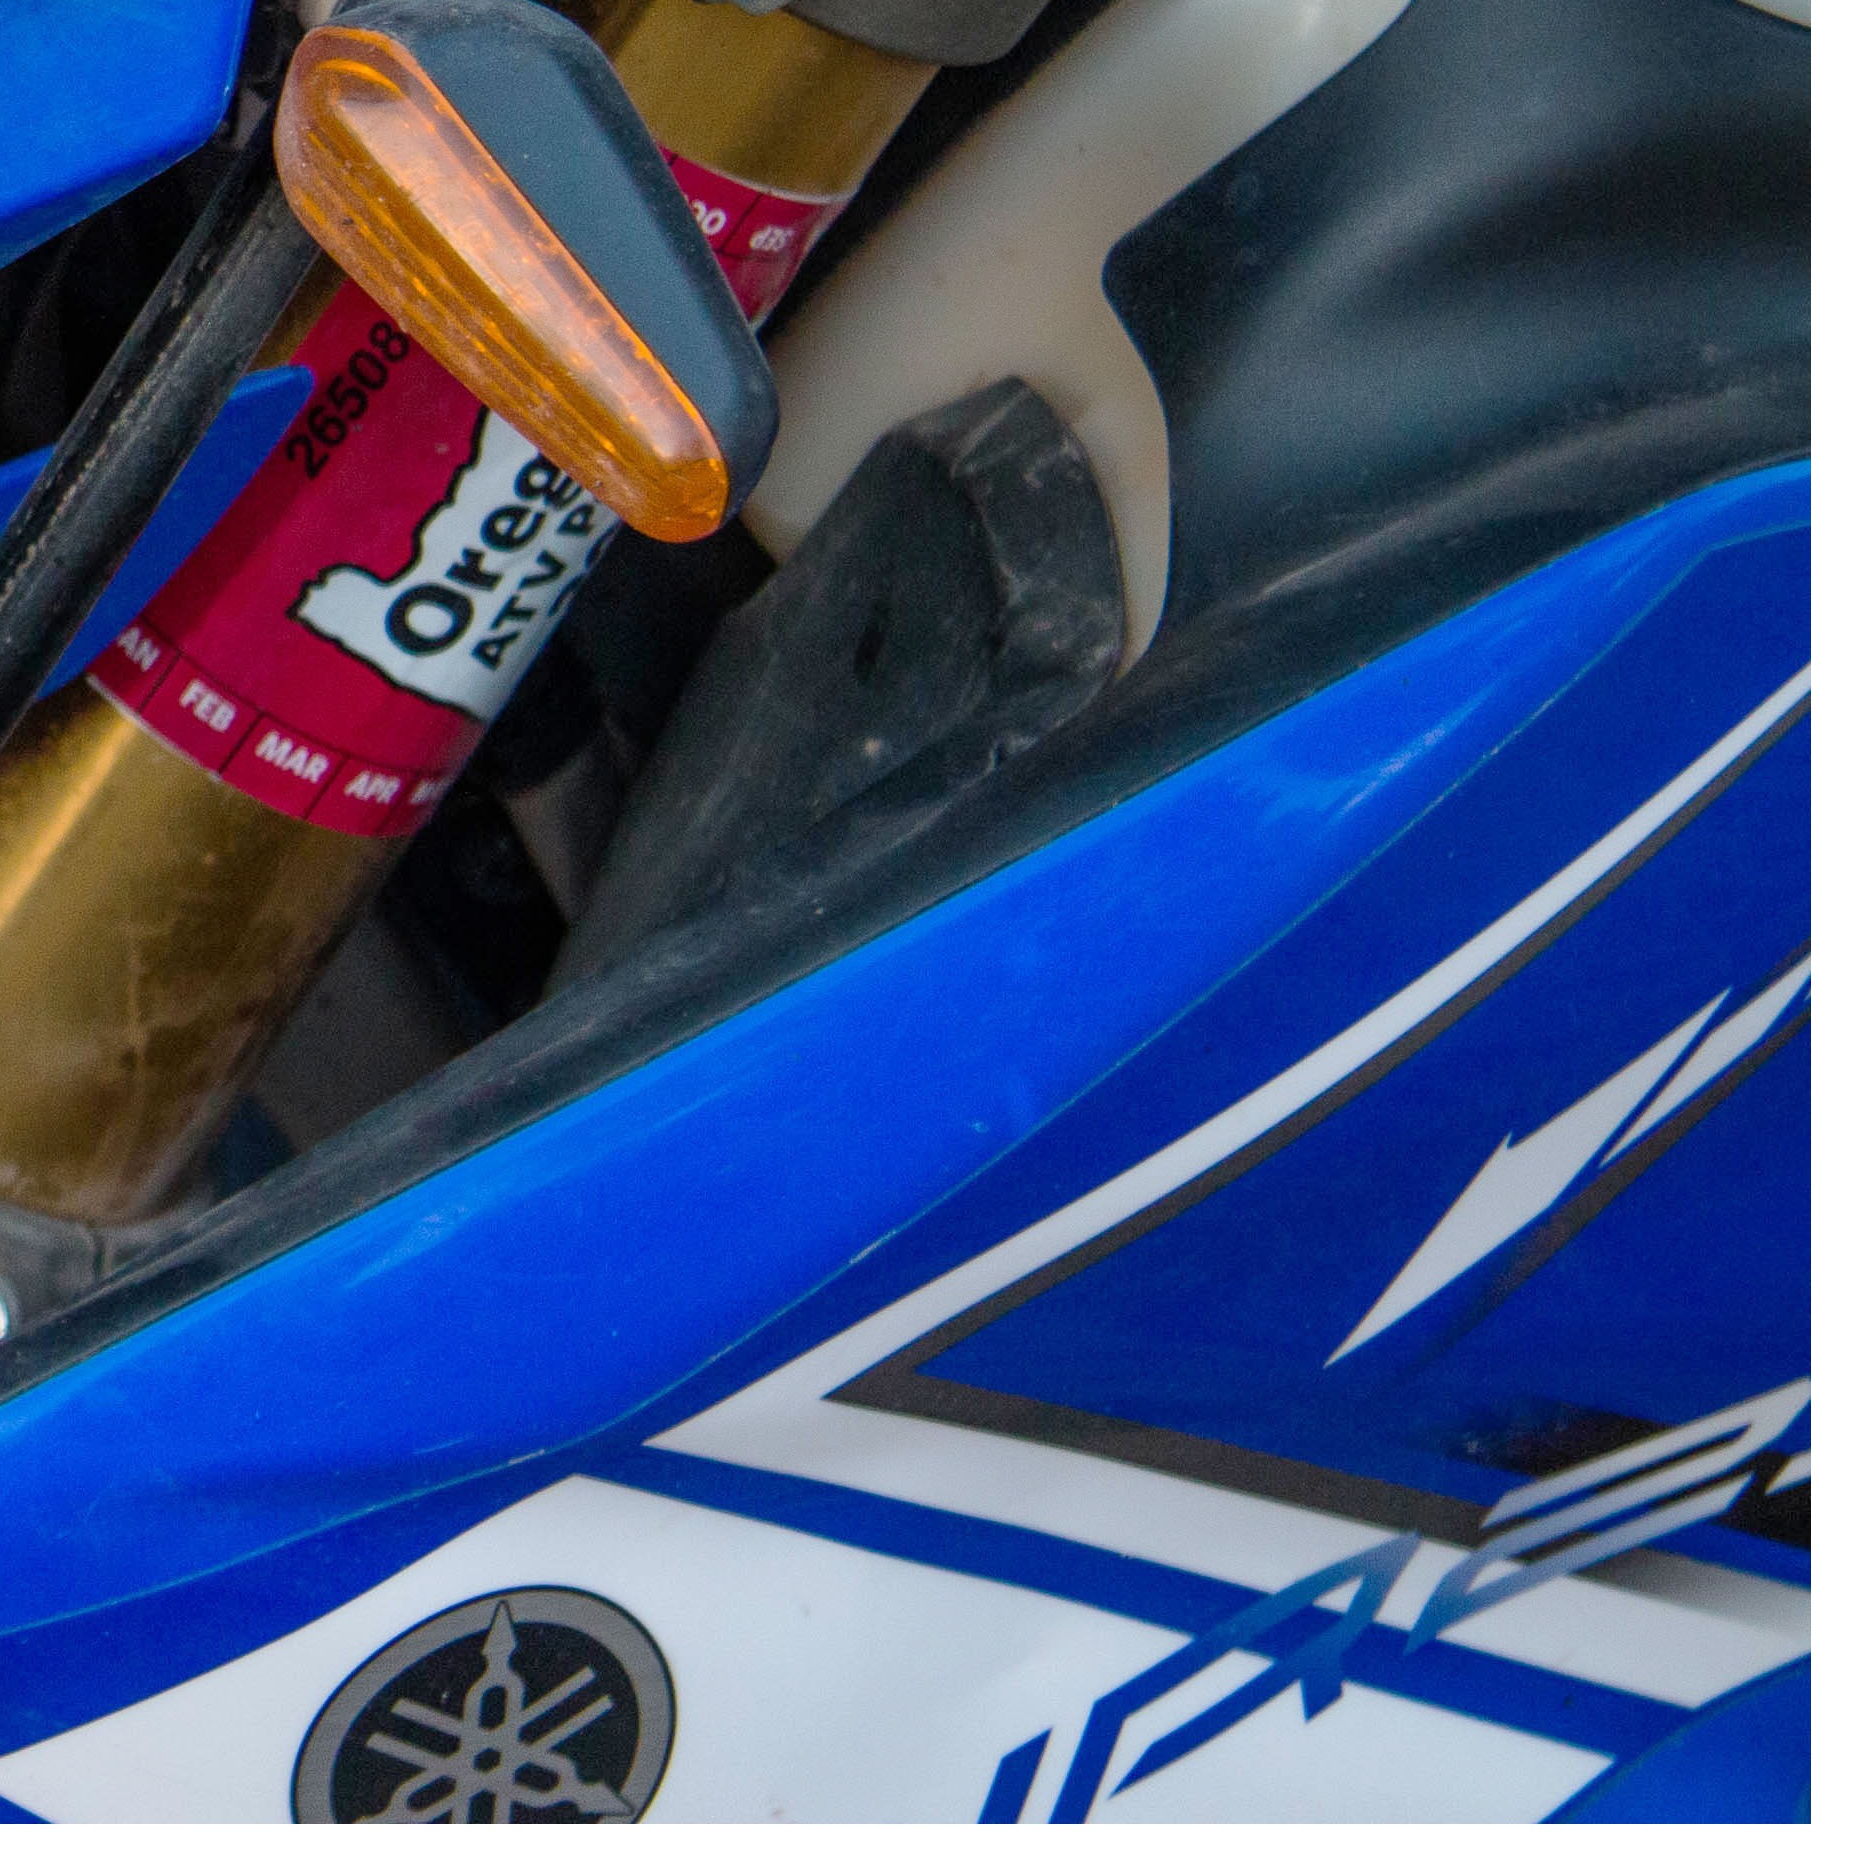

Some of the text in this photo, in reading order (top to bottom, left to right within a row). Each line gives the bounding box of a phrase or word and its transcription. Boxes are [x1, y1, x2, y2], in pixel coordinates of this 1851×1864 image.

[285, 320, 410, 480] 26508
[471, 548, 568, 670] ATV
[178, 677, 237, 733] FEB
[254, 729, 330, 785] MAR
[343, 769, 401, 804] APR
